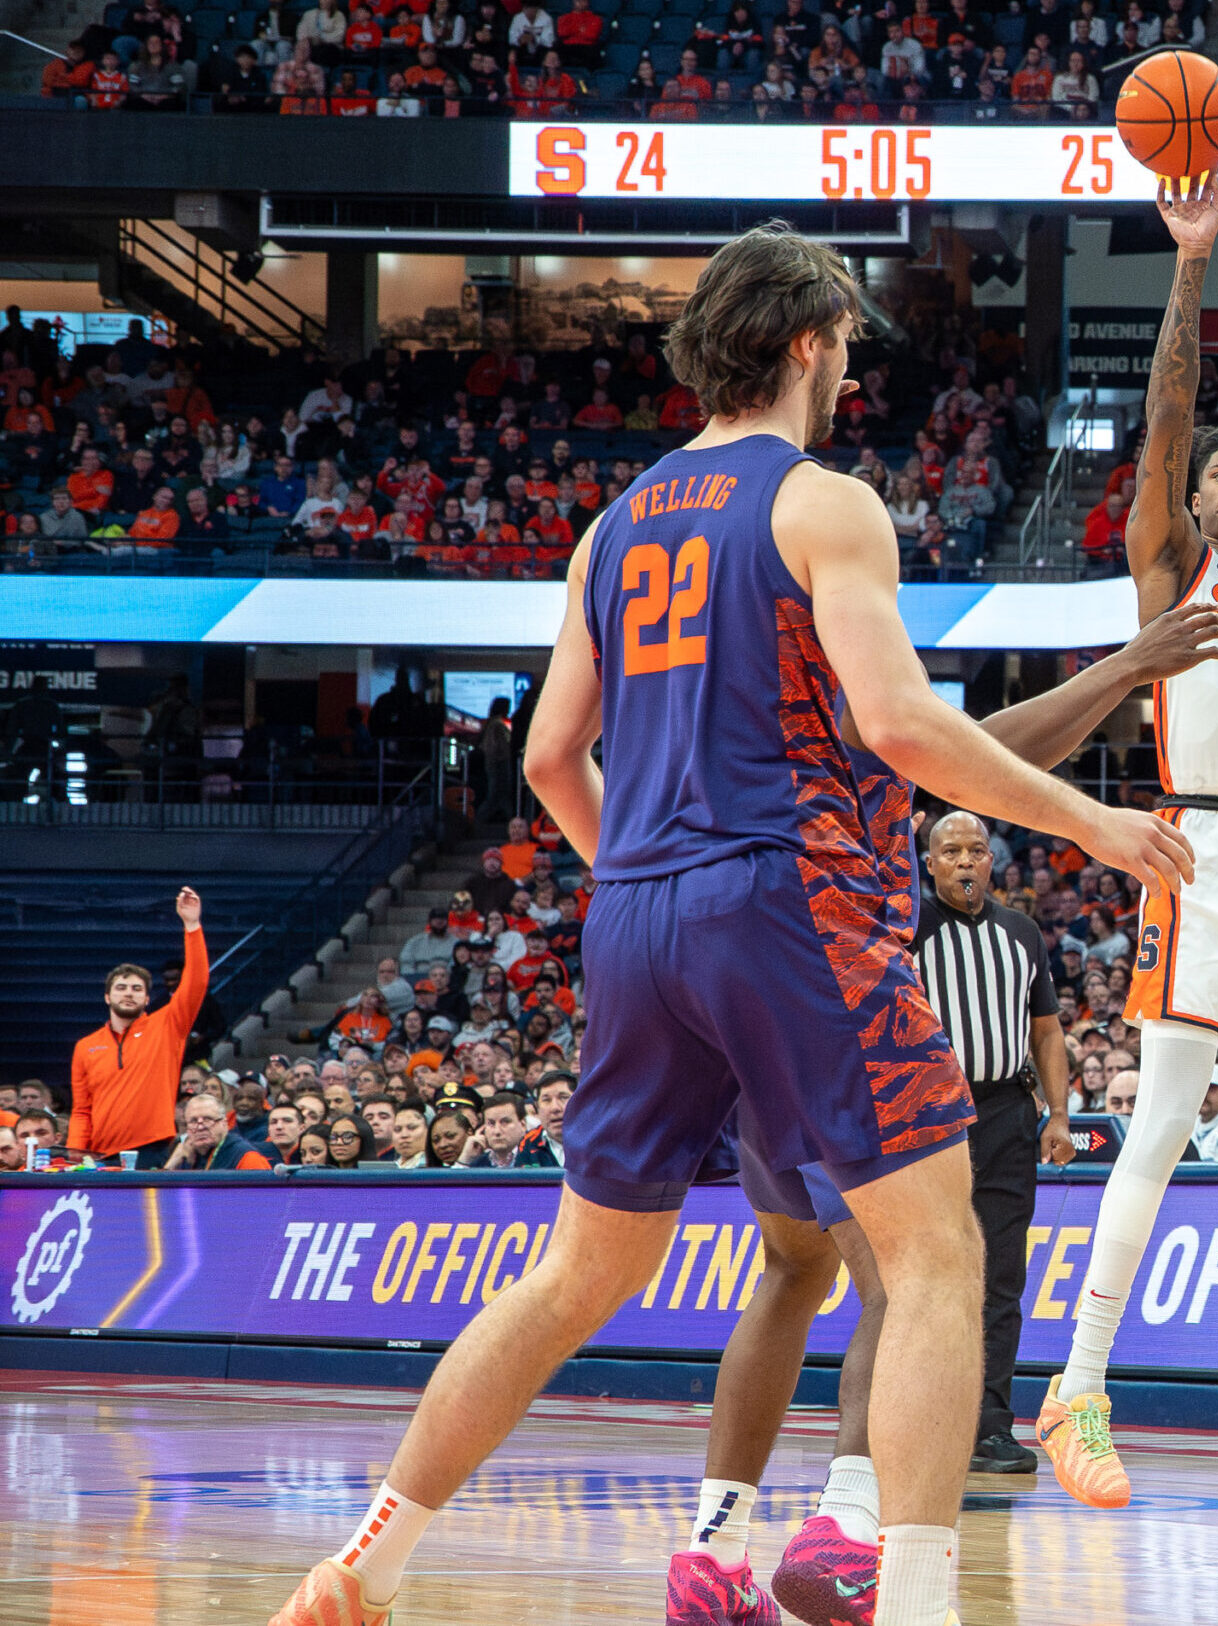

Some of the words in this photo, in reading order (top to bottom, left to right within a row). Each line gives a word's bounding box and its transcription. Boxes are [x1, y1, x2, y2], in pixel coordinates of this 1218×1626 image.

[536, 126, 587, 196] S
[616, 131, 667, 191] 24
[821, 129, 931, 199] 5:05
[1061, 135, 1113, 194] 25
[1083, 323, 1157, 339] AVENUE
[1068, 356, 1129, 373] ARKING
[629, 474, 738, 525] WELLING
[622, 535, 710, 677] 22
[1137, 924, 1162, 971] S
[27, 1229, 78, 1286] pf
[269, 1222, 376, 1301] THE
[372, 1221, 549, 1304] OFFICI
